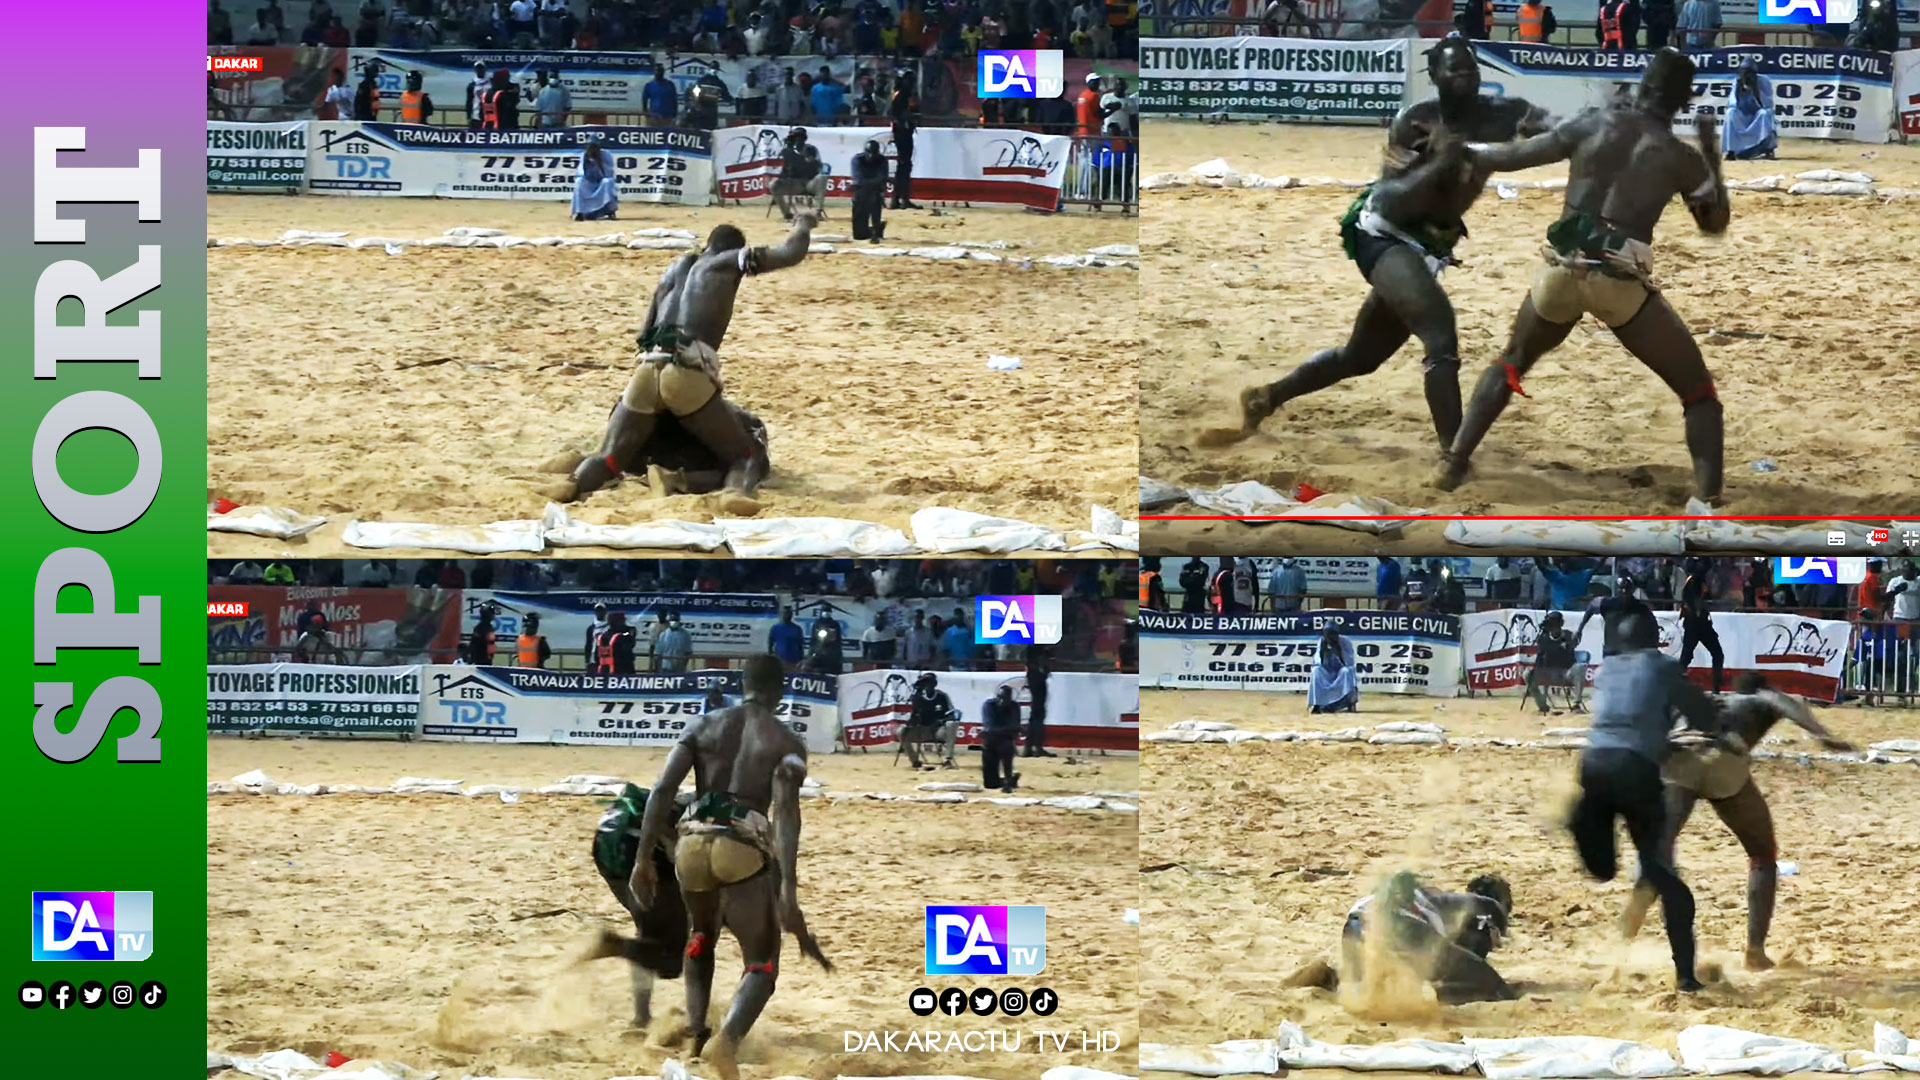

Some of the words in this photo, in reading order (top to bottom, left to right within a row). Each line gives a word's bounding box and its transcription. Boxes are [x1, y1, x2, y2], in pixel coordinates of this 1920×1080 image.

[1244, 48, 1405, 72] PROFESSIONNEL
[1509, 50, 1588, 66] TRAVAUX
[1594, 54, 1617, 67] DE
[1778, 54, 1834, 69] GENIE
[1839, 55, 1884, 74] CIVIL
[1161, 81, 1184, 91] 33
[1228, 81, 1249, 91] 54
[1254, 81, 1277, 92] 53
[1291, 82, 1310, 93] 77
[1314, 83, 1347, 93] 531
[1350, 84, 1375, 94] 66
[1378, 84, 1402, 94] 58
[1814, 84, 1862, 101] 25
[1189, 96, 1401, 110] sapronetsa@gmail.com
[394, 130, 461, 143] TRAVAUX
[465, 132, 486, 143] DE
[490, 133, 564, 144] BATIMENT
[618, 132, 664, 144] GENIE
[667, 133, 705, 149] CIVIL
[347, 143, 369, 153] ETS
[210, 158, 225, 167] 77
[229, 159, 256, 167] 531
[260, 159, 280, 168] 66
[326, 155, 391, 179] TDR
[481, 156, 516, 168] 77
[524, 156, 580, 169] 575
[647, 157, 687, 171] 25
[480, 173, 531, 183] Cité
[722, 182, 738, 193] 77
[1192, 617, 1213, 629] DE
[1218, 618, 1298, 630] BATIMENT
[1359, 617, 1408, 630] GENIE
[1413, 618, 1452, 635] CIVIL
[1209, 643, 1246, 656] 77
[1256, 643, 1317, 657] 575
[1390, 644, 1433, 660] 25
[1208, 661, 1264, 672] Cité
[1473, 671, 1488, 683] 77
[207, 673, 274, 692] TOYAGE
[279, 673, 420, 695] PROFESSIONNEL
[510, 673, 578, 688] TRAVAUX
[583, 676, 604, 688] DE
[608, 676, 684, 689] BATIMENT
[792, 679, 831, 695] CIVIL
[461, 688, 484, 699] ETS
[230, 703, 262, 711] 832
[265, 703, 284, 711] 54
[287, 703, 308, 712] 53
[320, 703, 337, 712] 77
[341, 704, 369, 713] 531
[372, 705, 394, 713] 66
[396, 705, 418, 714] 58
[440, 700, 506, 724] TDR
[598, 702, 635, 714] 77
[643, 702, 701, 715] 575
[230, 715, 417, 727] sapronetsa@gmail.com
[598, 718, 650, 729] Cité
[849, 728, 865, 740] 77
